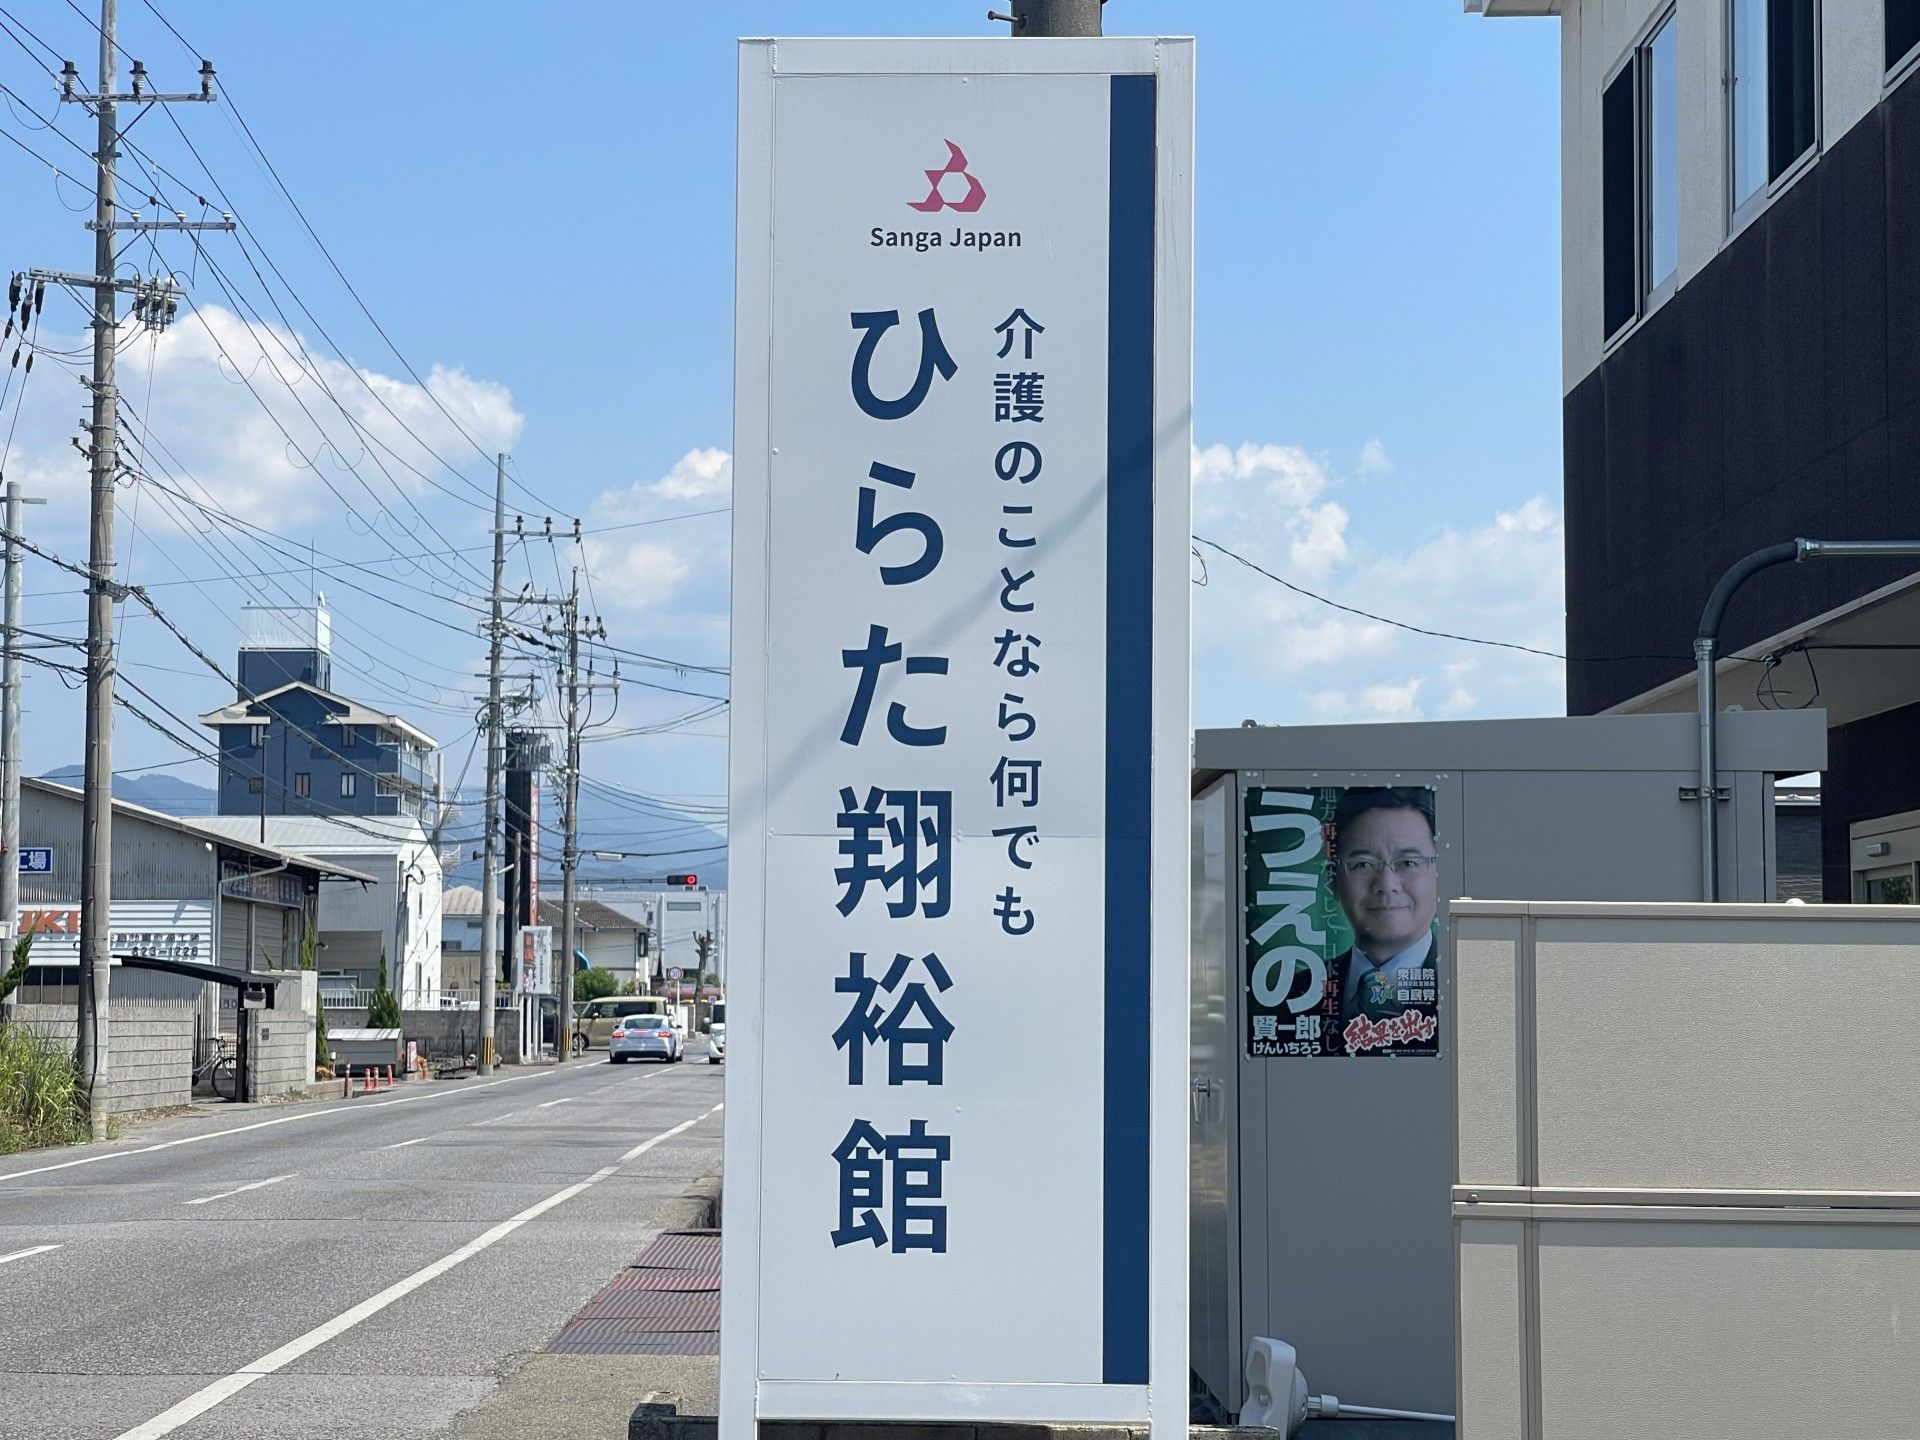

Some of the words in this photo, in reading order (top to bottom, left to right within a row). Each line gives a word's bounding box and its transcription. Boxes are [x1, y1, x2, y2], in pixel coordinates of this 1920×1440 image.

[871, 227, 942, 253] Sanga
[949, 227, 1021, 252] Japan
[989, 308, 1045, 936] 介護のことなら何でも
[831, 307, 958, 1254] ひらた翔裕館
[1250, 791, 1327, 1013] うえの
[1398, 968, 1435, 981] 衆議院
[1398, 989, 1435, 1001] 自民党
[1253, 1015, 1321, 1040] 賢一郎
[1344, 1010, 1437, 1053] 結果を出す
[1253, 1042, 1321, 1055] けんいちろう
